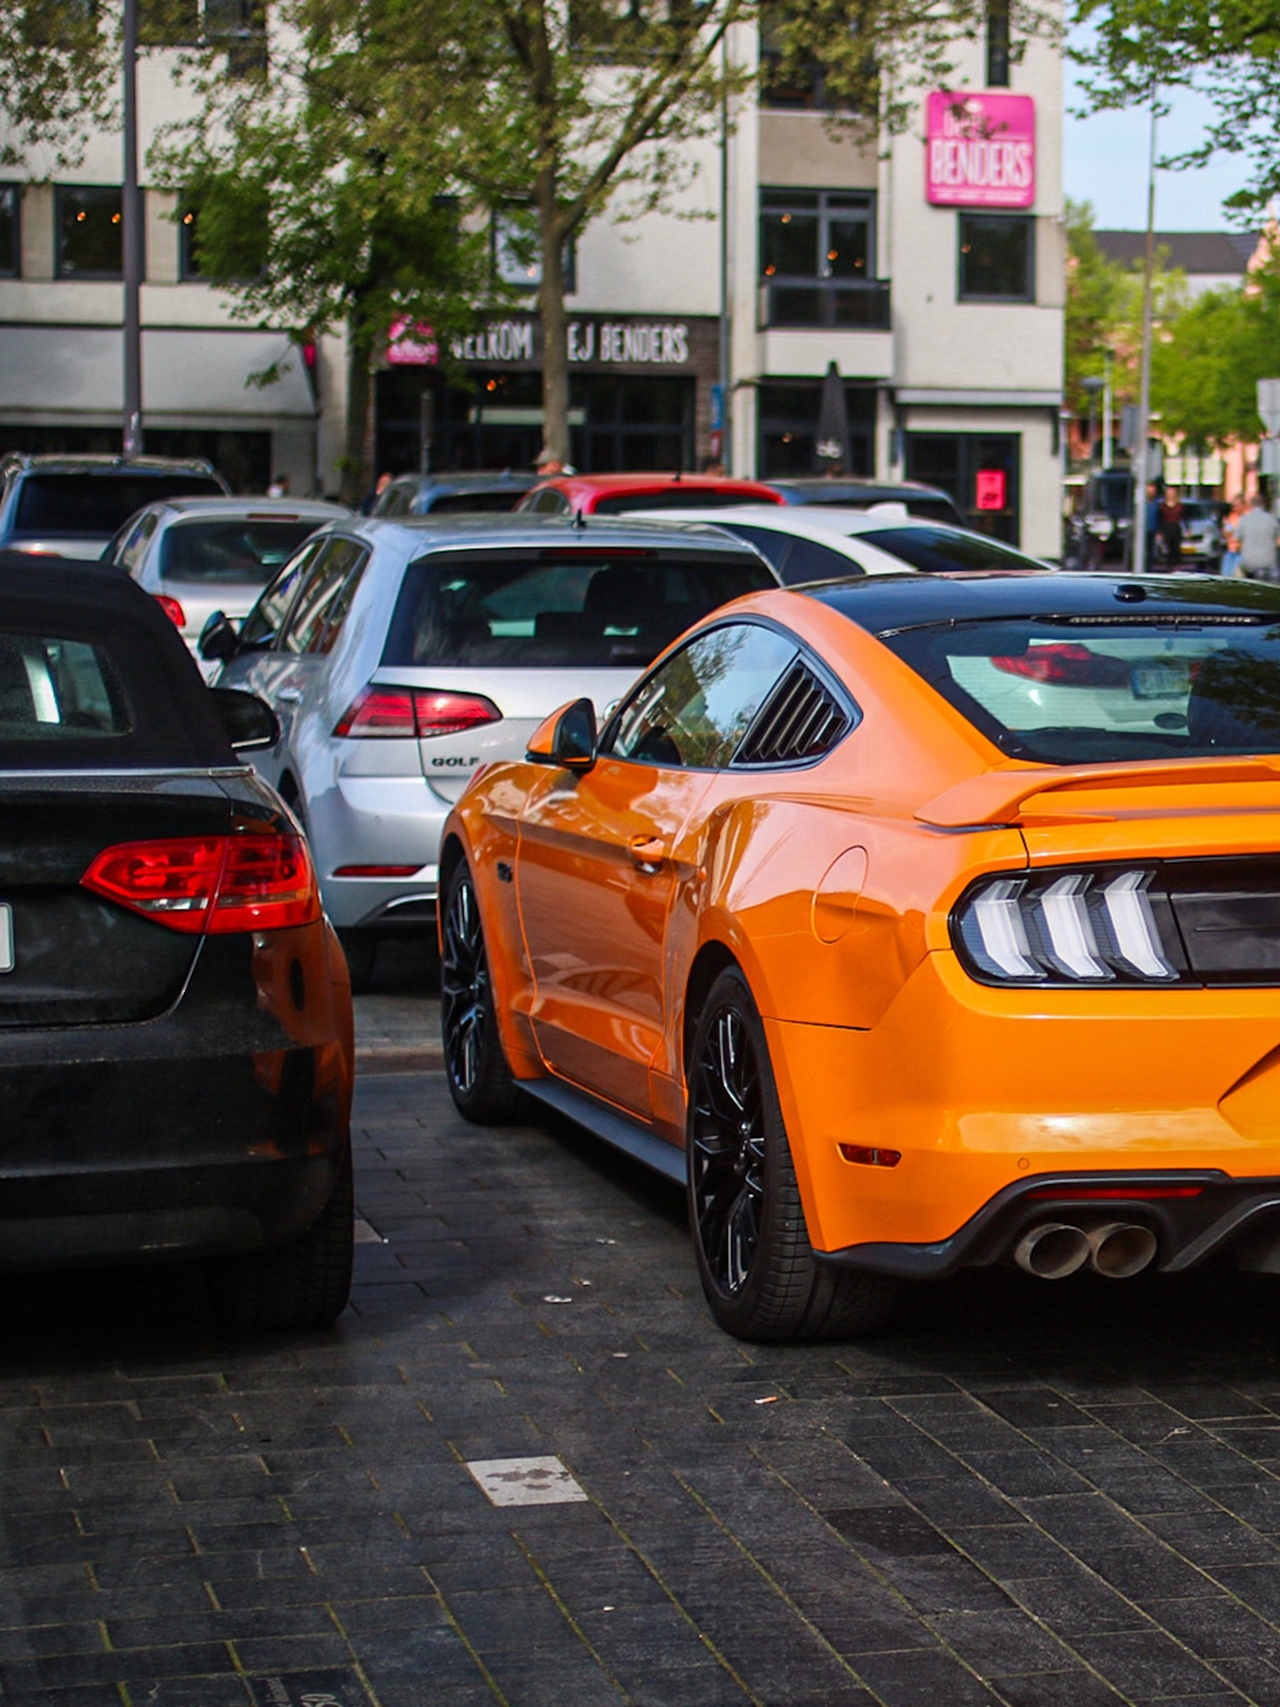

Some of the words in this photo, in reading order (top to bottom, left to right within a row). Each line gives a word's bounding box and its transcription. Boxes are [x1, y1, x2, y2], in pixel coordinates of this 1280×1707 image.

[931, 140, 1031, 188] BENDERS
[601, 323, 688, 363] BENDERS
[432, 757, 480, 767] GOLF
